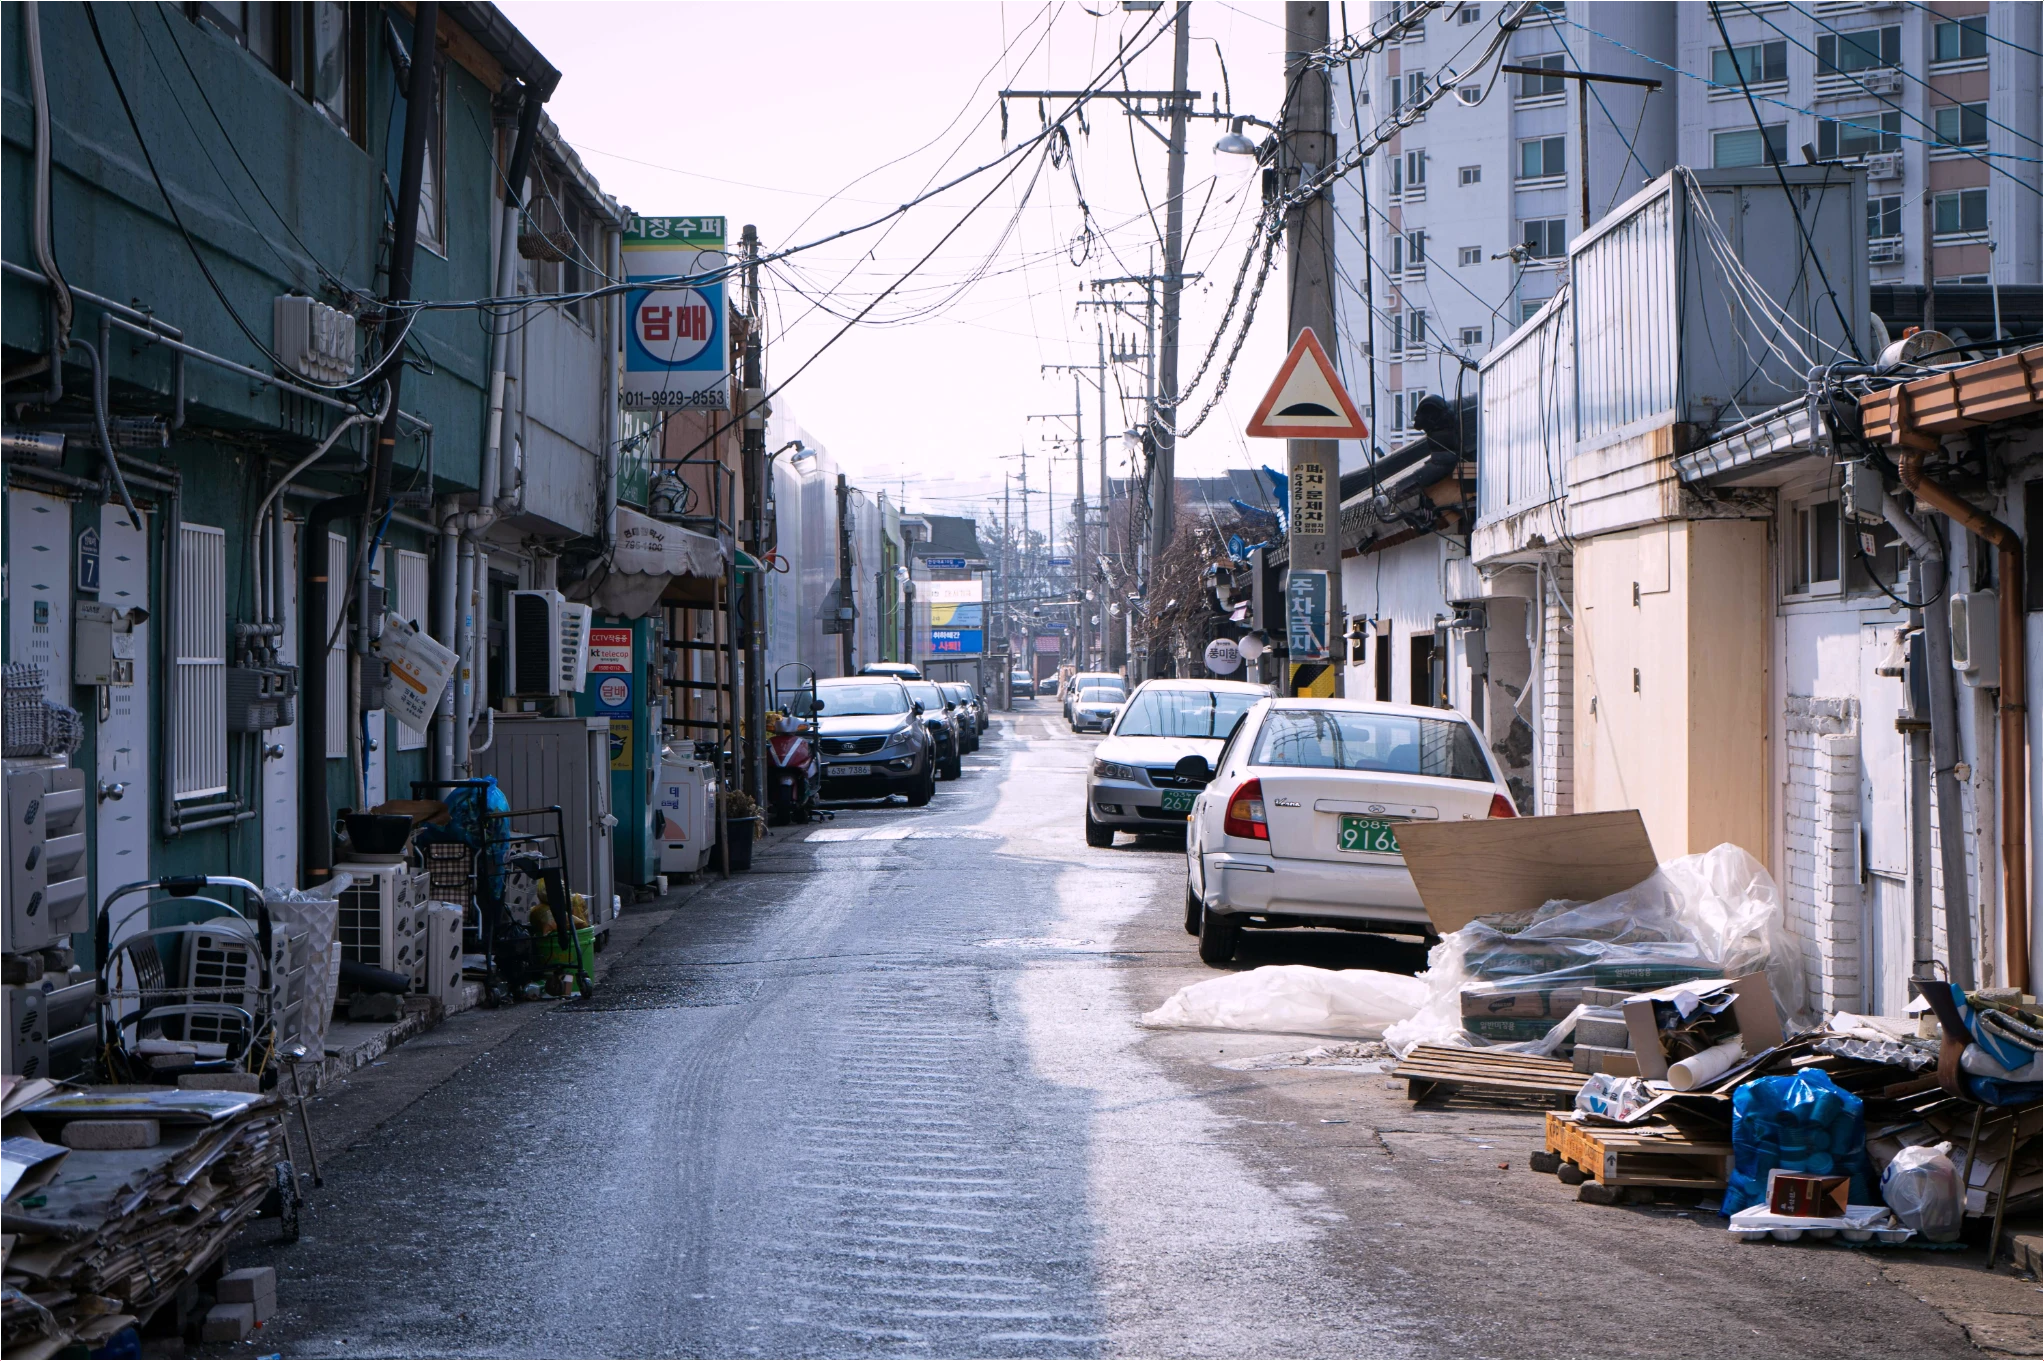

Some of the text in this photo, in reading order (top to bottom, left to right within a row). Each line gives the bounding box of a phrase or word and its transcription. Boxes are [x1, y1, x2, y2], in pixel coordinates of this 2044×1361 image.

[641, 305, 707, 341] 담배
[625, 390, 725, 406] 011-9929-0553
[87, 559, 94, 583] 7
[1290, 578, 1316, 652] 주차금지
[591, 634, 628, 643] CCTV작동중
[590, 648, 629, 658] kt telecop
[1208, 648, 1239, 659] 풍미향
[602, 685, 626, 698] 담배
[1163, 797, 1192, 810] 267
[1615, 967, 1652, 978] 일반미장용
[1480, 1020, 1516, 1031] 일반미장용
